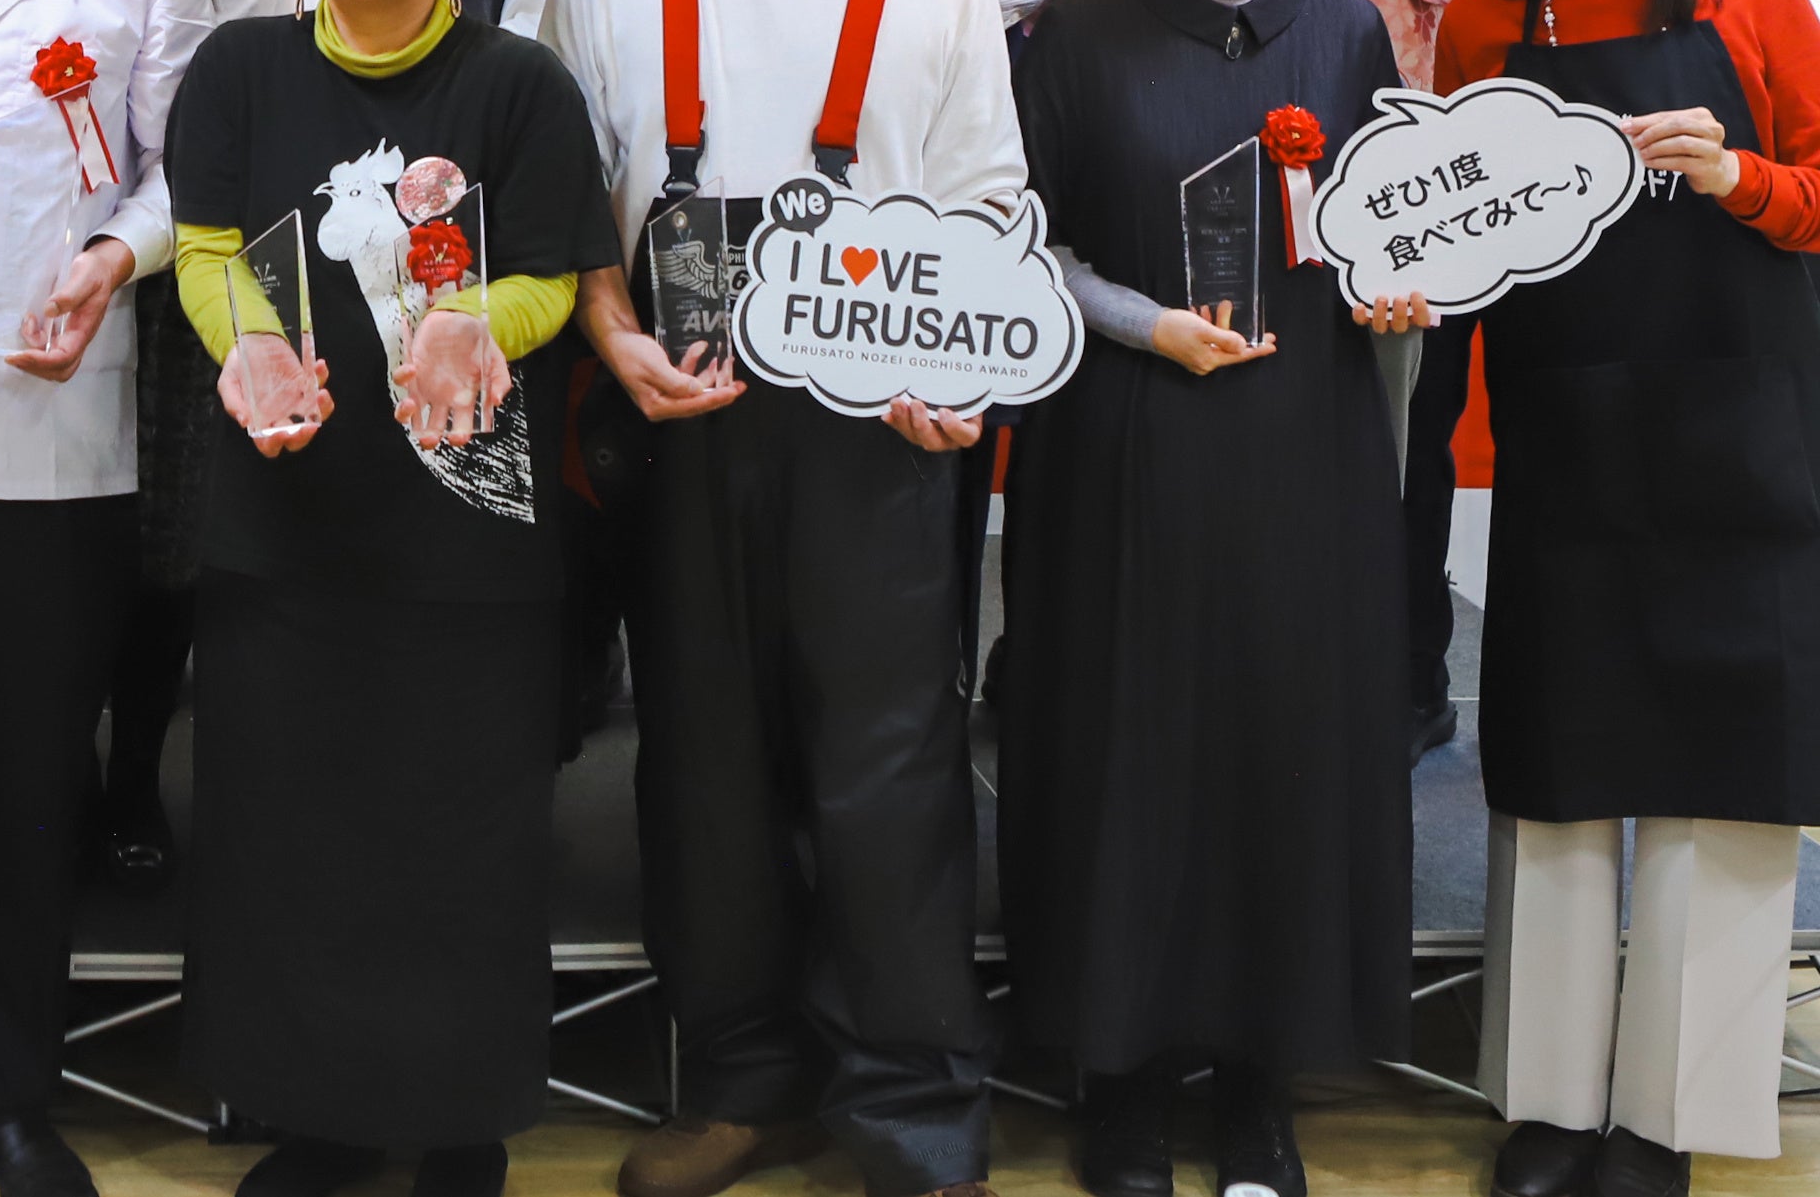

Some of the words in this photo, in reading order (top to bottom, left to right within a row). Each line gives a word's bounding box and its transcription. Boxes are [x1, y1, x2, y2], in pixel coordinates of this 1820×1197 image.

[776, 188, 827, 222] We
[1364, 151, 1491, 220] ぜひ1度
[789, 239, 802, 283] I
[783, 294, 1039, 361] FURUSATO
[782, 343, 855, 360] FURUSATO
[861, 352, 903, 366] NOZEI
[908, 357, 973, 373] GOCHISO
[979, 365, 1029, 379] AWARD
